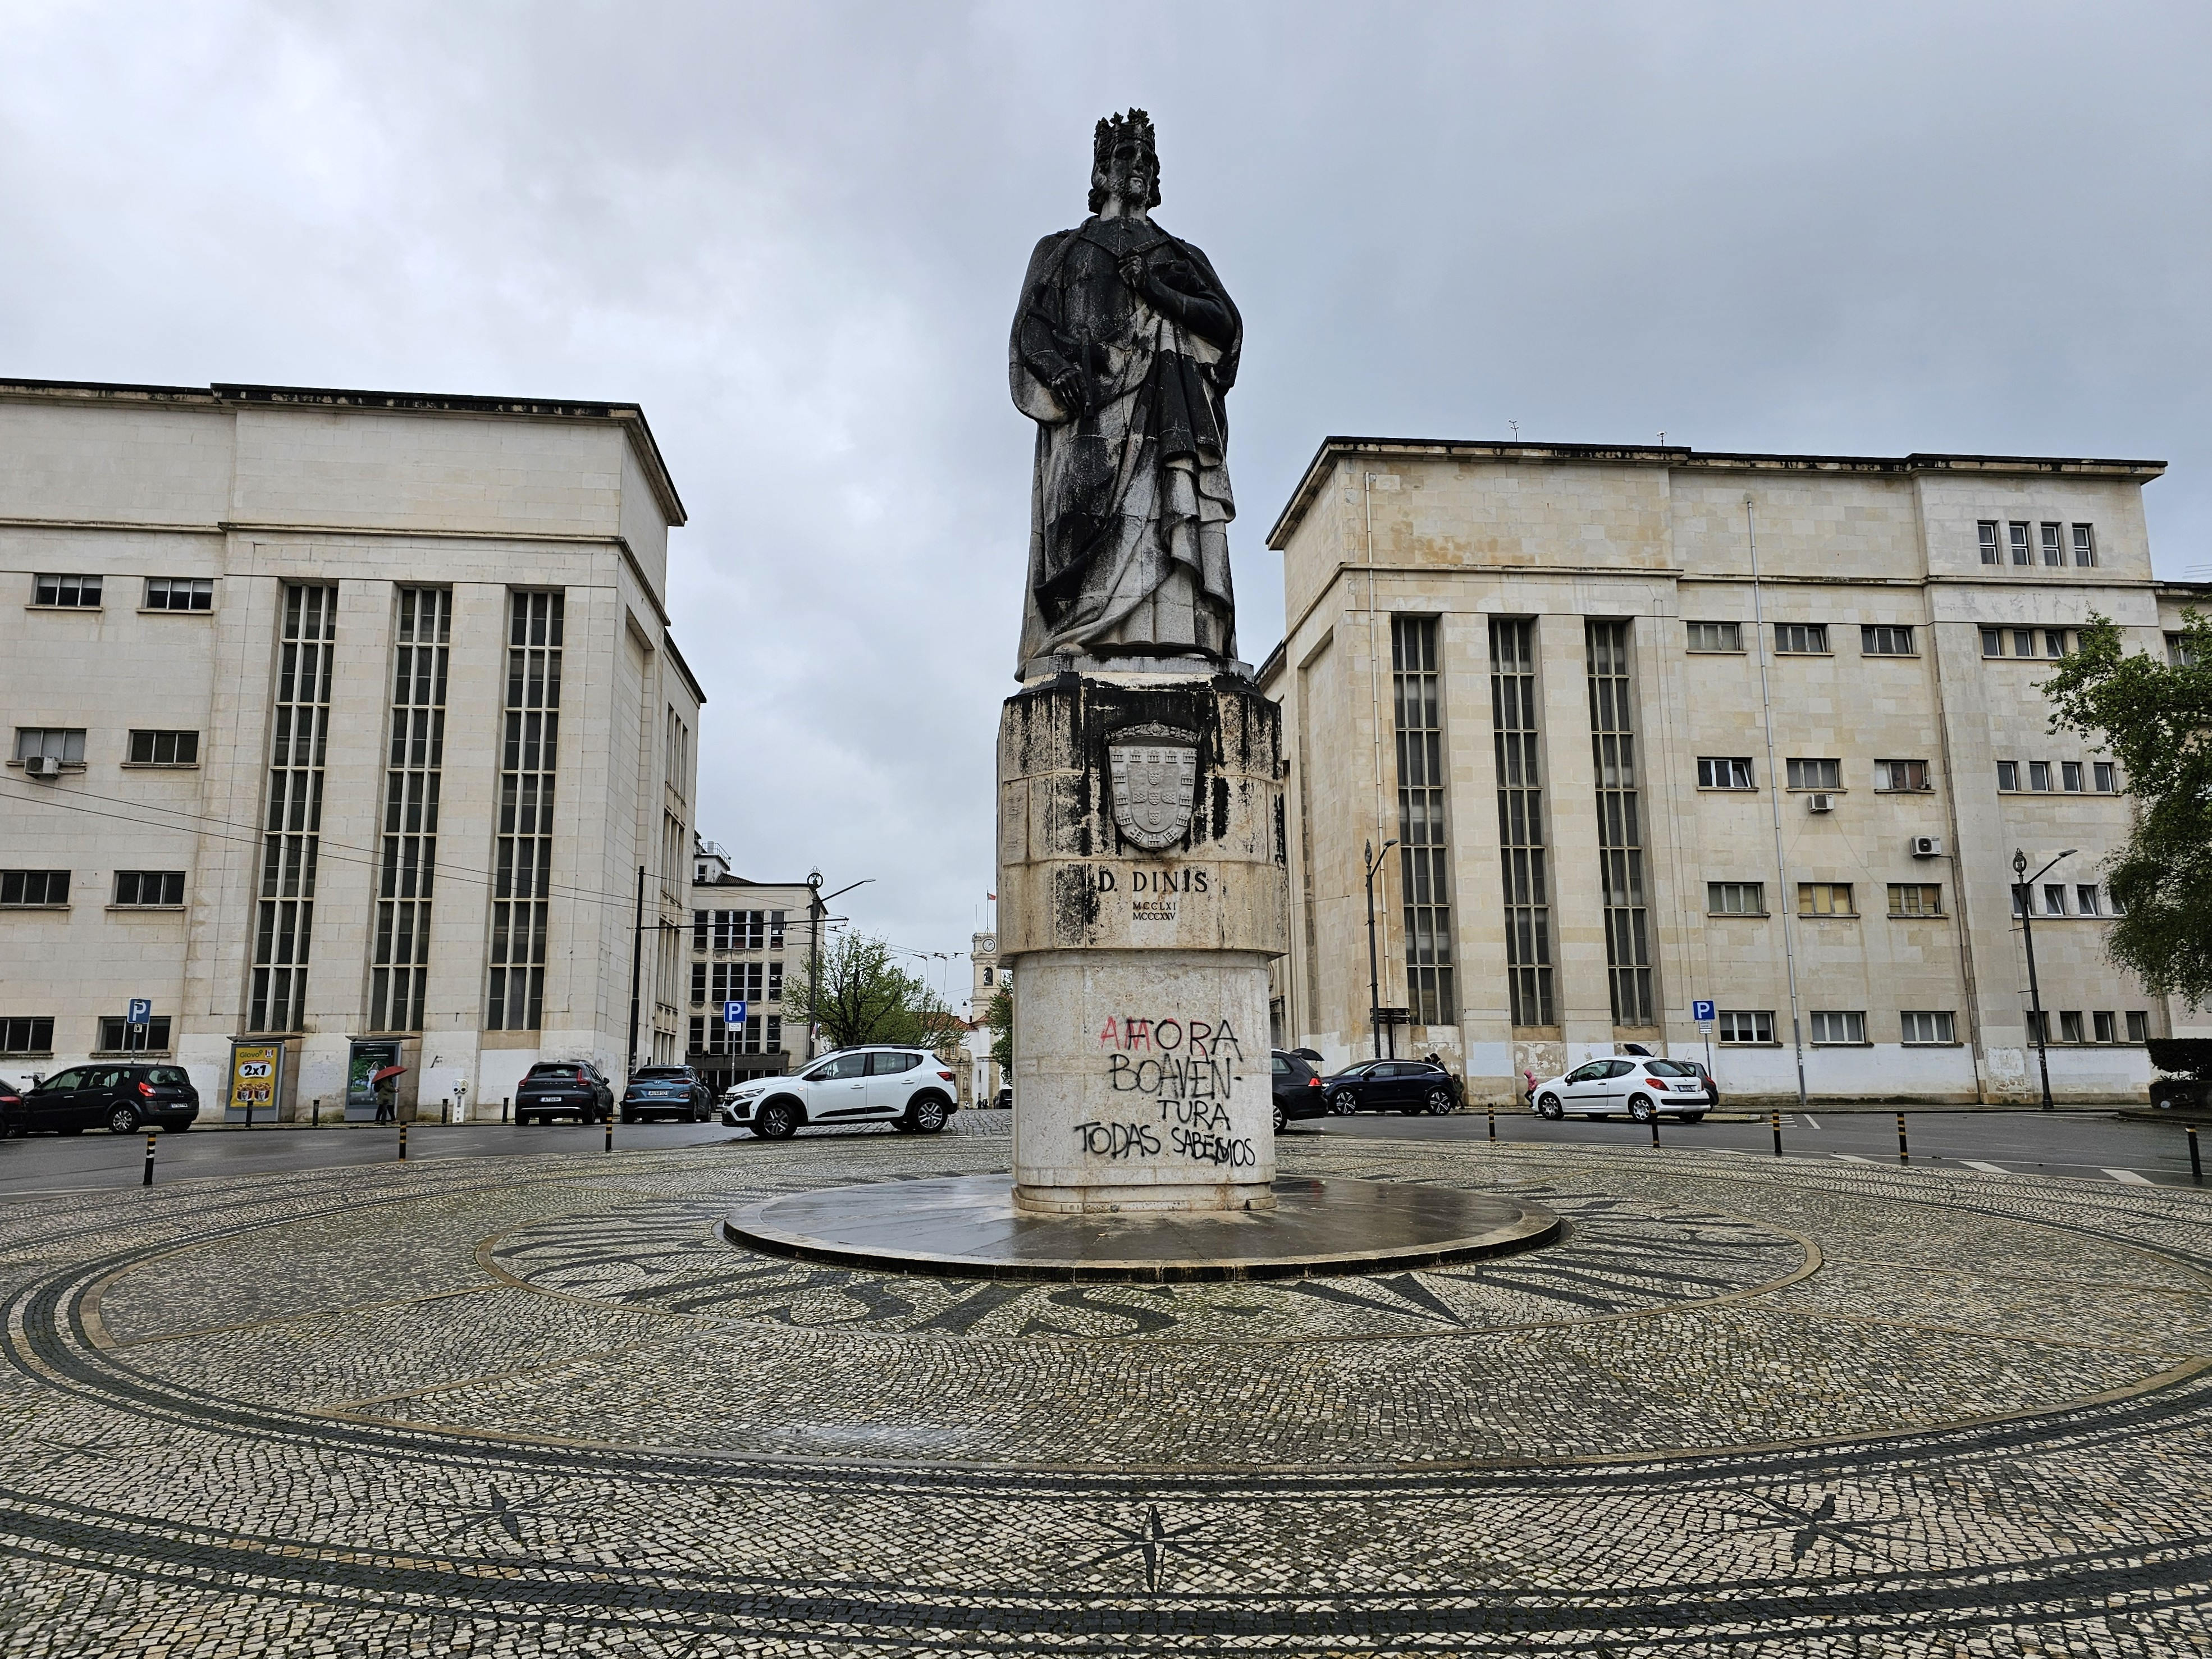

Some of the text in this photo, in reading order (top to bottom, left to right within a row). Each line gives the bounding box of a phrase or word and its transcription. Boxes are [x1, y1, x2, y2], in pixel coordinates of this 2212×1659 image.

[1099, 870, 1208, 892] D. DINIS
[1132, 902, 1176, 910] MCCLXI
[1132, 912, 1176, 921] MCCCXXV
[132, 1000, 147, 1021] P
[729, 1003, 742, 1021] P
[1697, 1002, 1710, 1019] P
[244, 1064, 267, 1076] 2x1
[1157, 1100, 1231, 1131] TURA
[1073, 1121, 1161, 1159] TODAS
